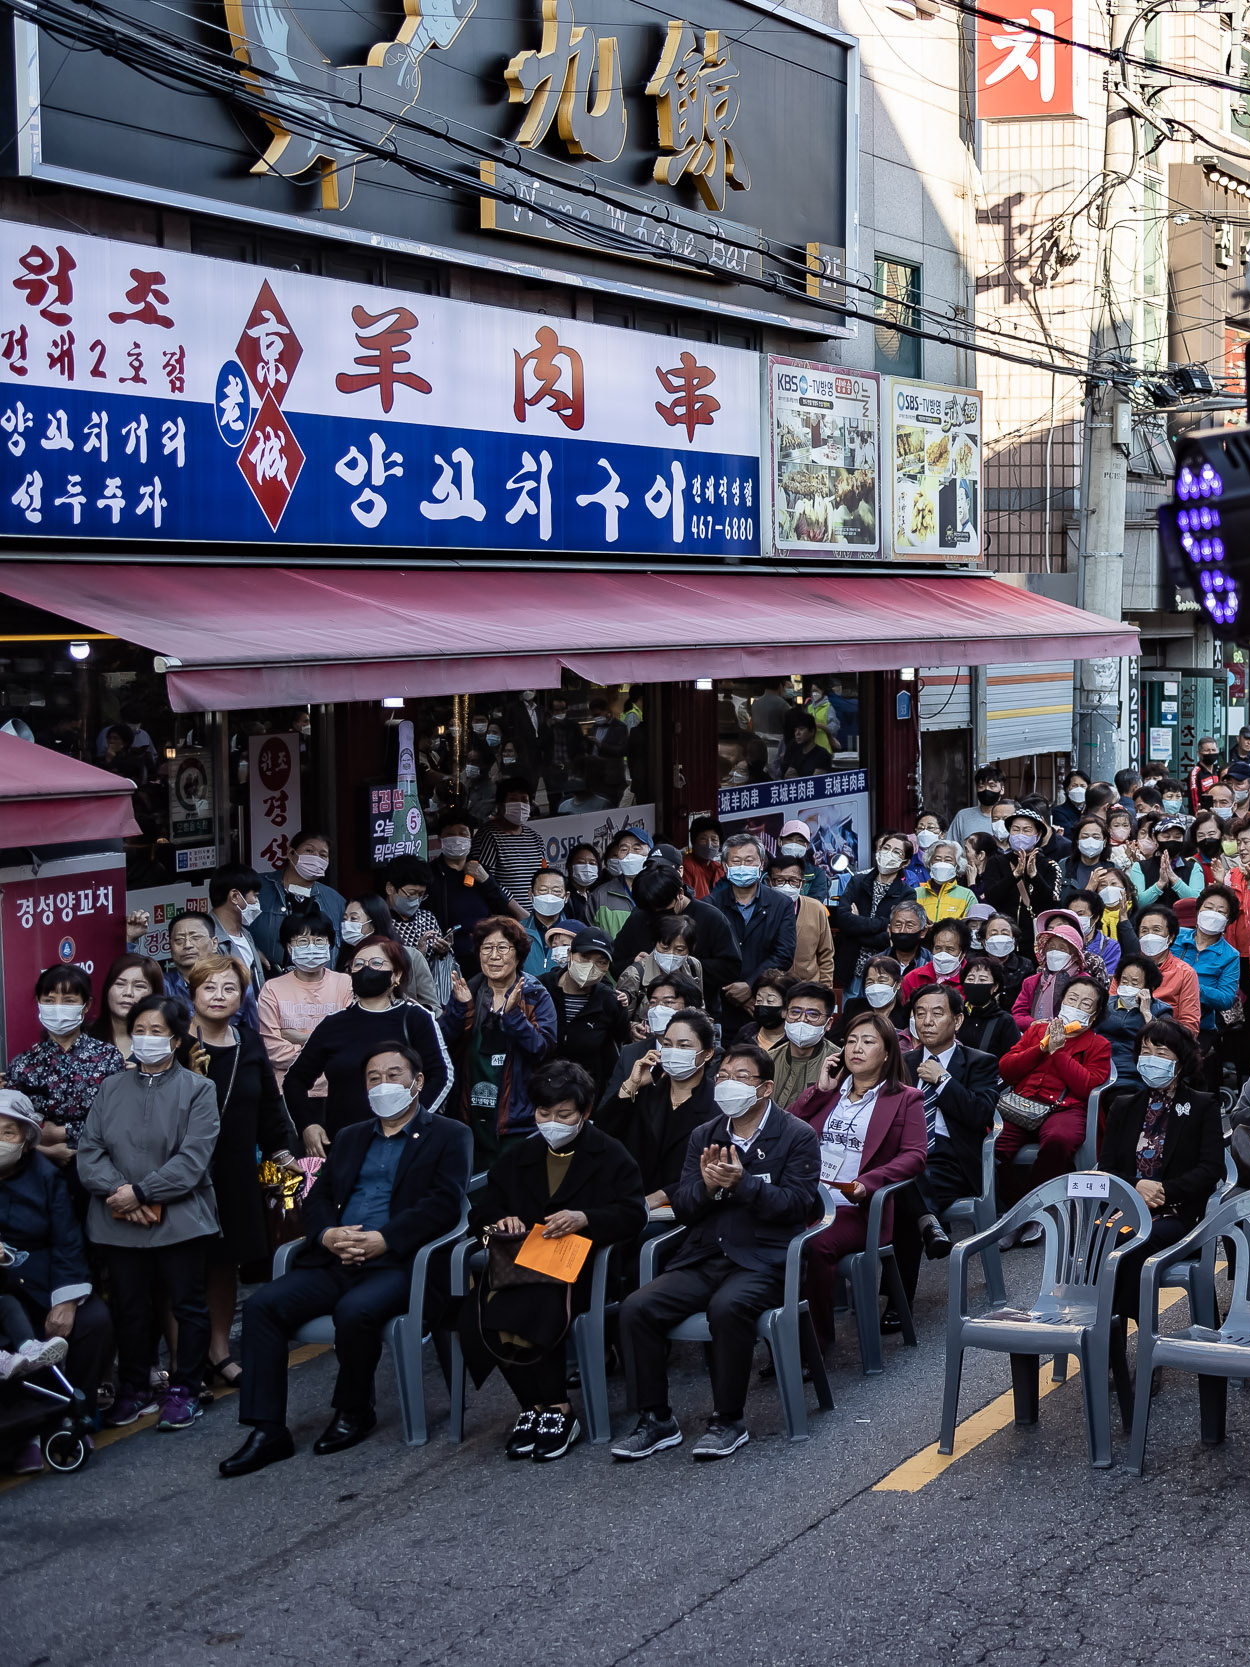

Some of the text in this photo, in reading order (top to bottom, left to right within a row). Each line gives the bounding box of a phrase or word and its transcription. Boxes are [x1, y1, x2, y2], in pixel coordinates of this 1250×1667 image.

[985, 8, 1056, 102] 치
[710, 228, 752, 271] Bar
[12, 244, 176, 330] 원조
[335, 305, 722, 443] 羊肉串
[777, 372, 798, 392] KBS
[905, 394, 919, 411] SBS
[0, 400, 186, 468] 양꼬치거리
[11, 470, 168, 528] 선두주자
[334, 433, 686, 543] 양꼬치구이
[691, 515, 753, 540] 467-6880
[261, 751, 289, 776] 원조
[718, 773, 865, 812] 城羊肉串 京城羊肉串 京城羊肉串
[261, 789, 290, 870] 경성
[373, 819, 395, 838] 오늘
[17, 885, 114, 928] 경성양꼬치
[820, 1132, 865, 1151] 国美食
[829, 1118, 858, 1134] 建大
[1071, 1181, 1106, 1191] 초대석
